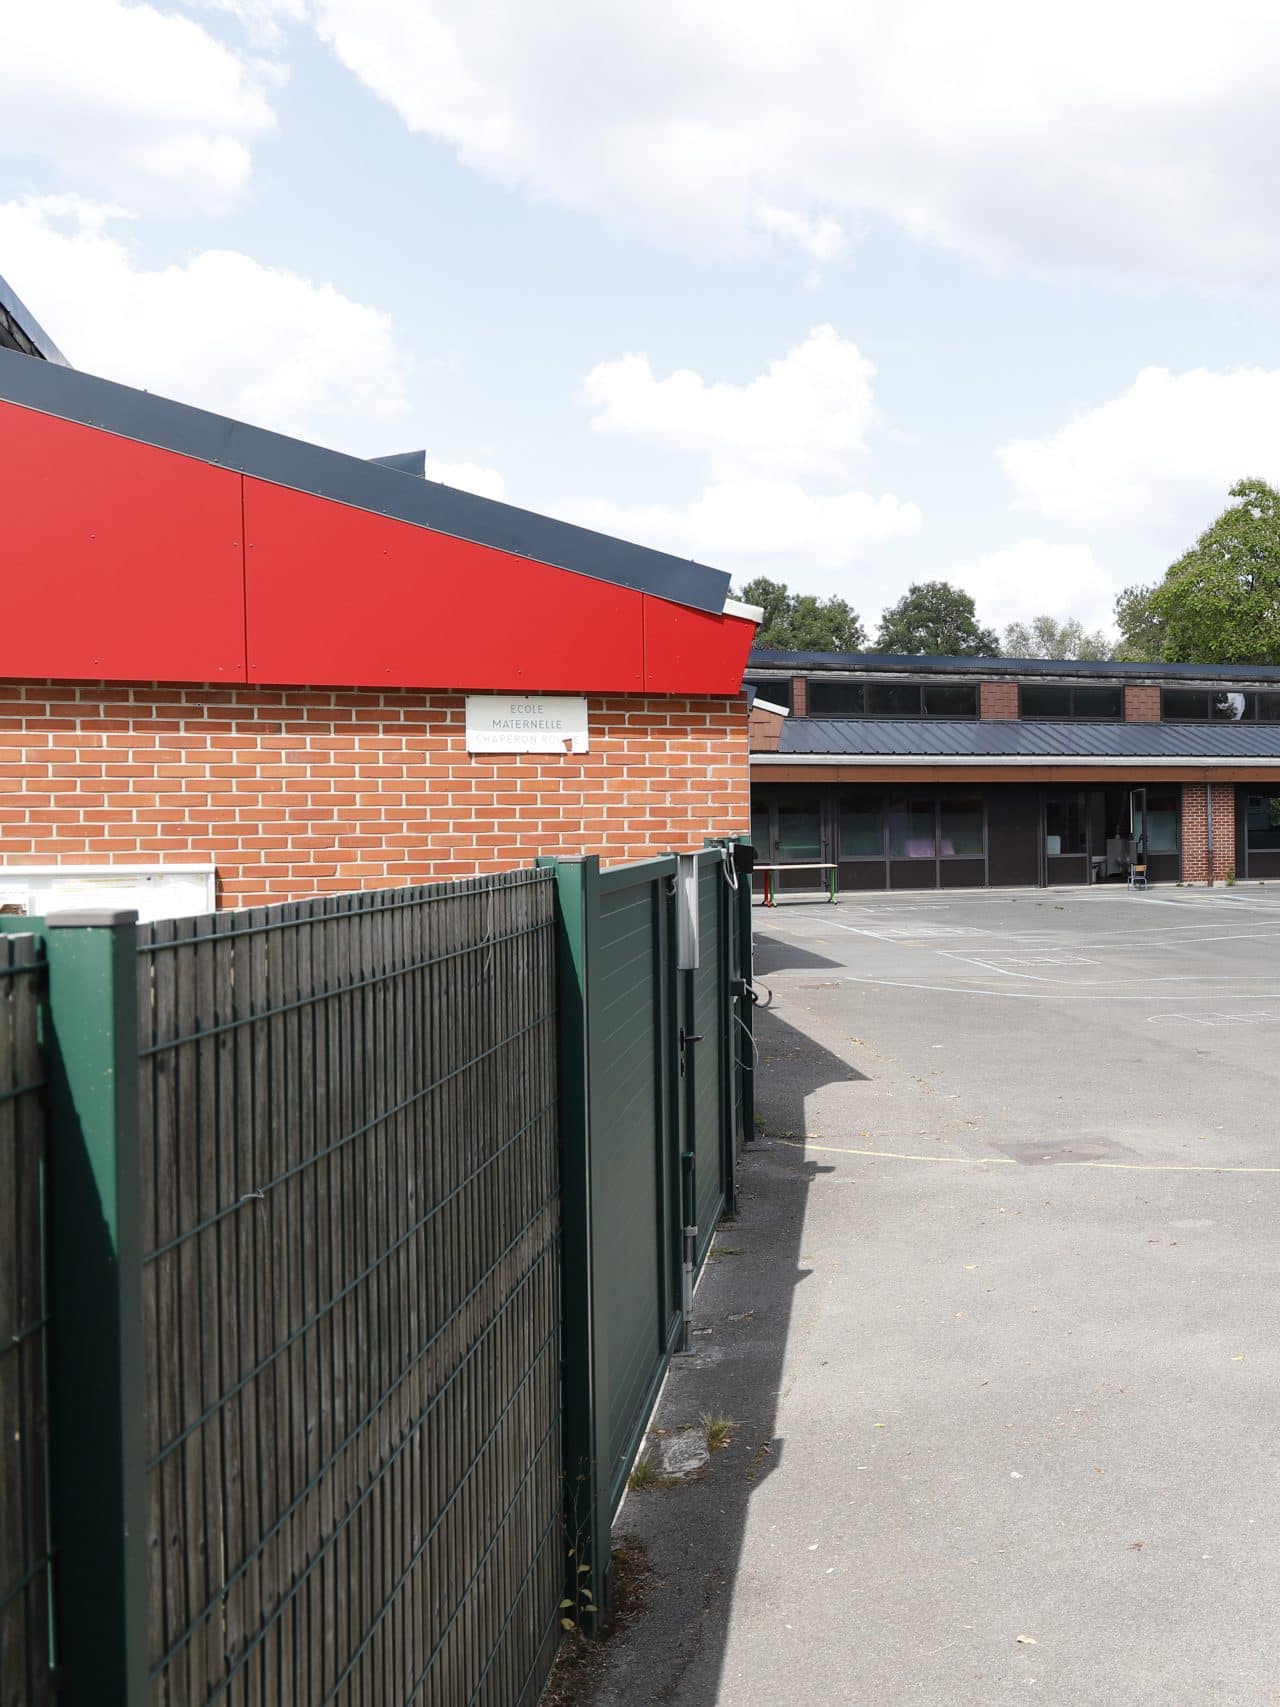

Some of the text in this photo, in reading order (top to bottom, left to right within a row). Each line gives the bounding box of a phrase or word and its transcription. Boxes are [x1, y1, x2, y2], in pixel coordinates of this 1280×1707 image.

[510, 704, 545, 714] ECOLE
[492, 719, 562, 729] MATERNELLE
[476, 734, 580, 745] CHAPERON ROUE
